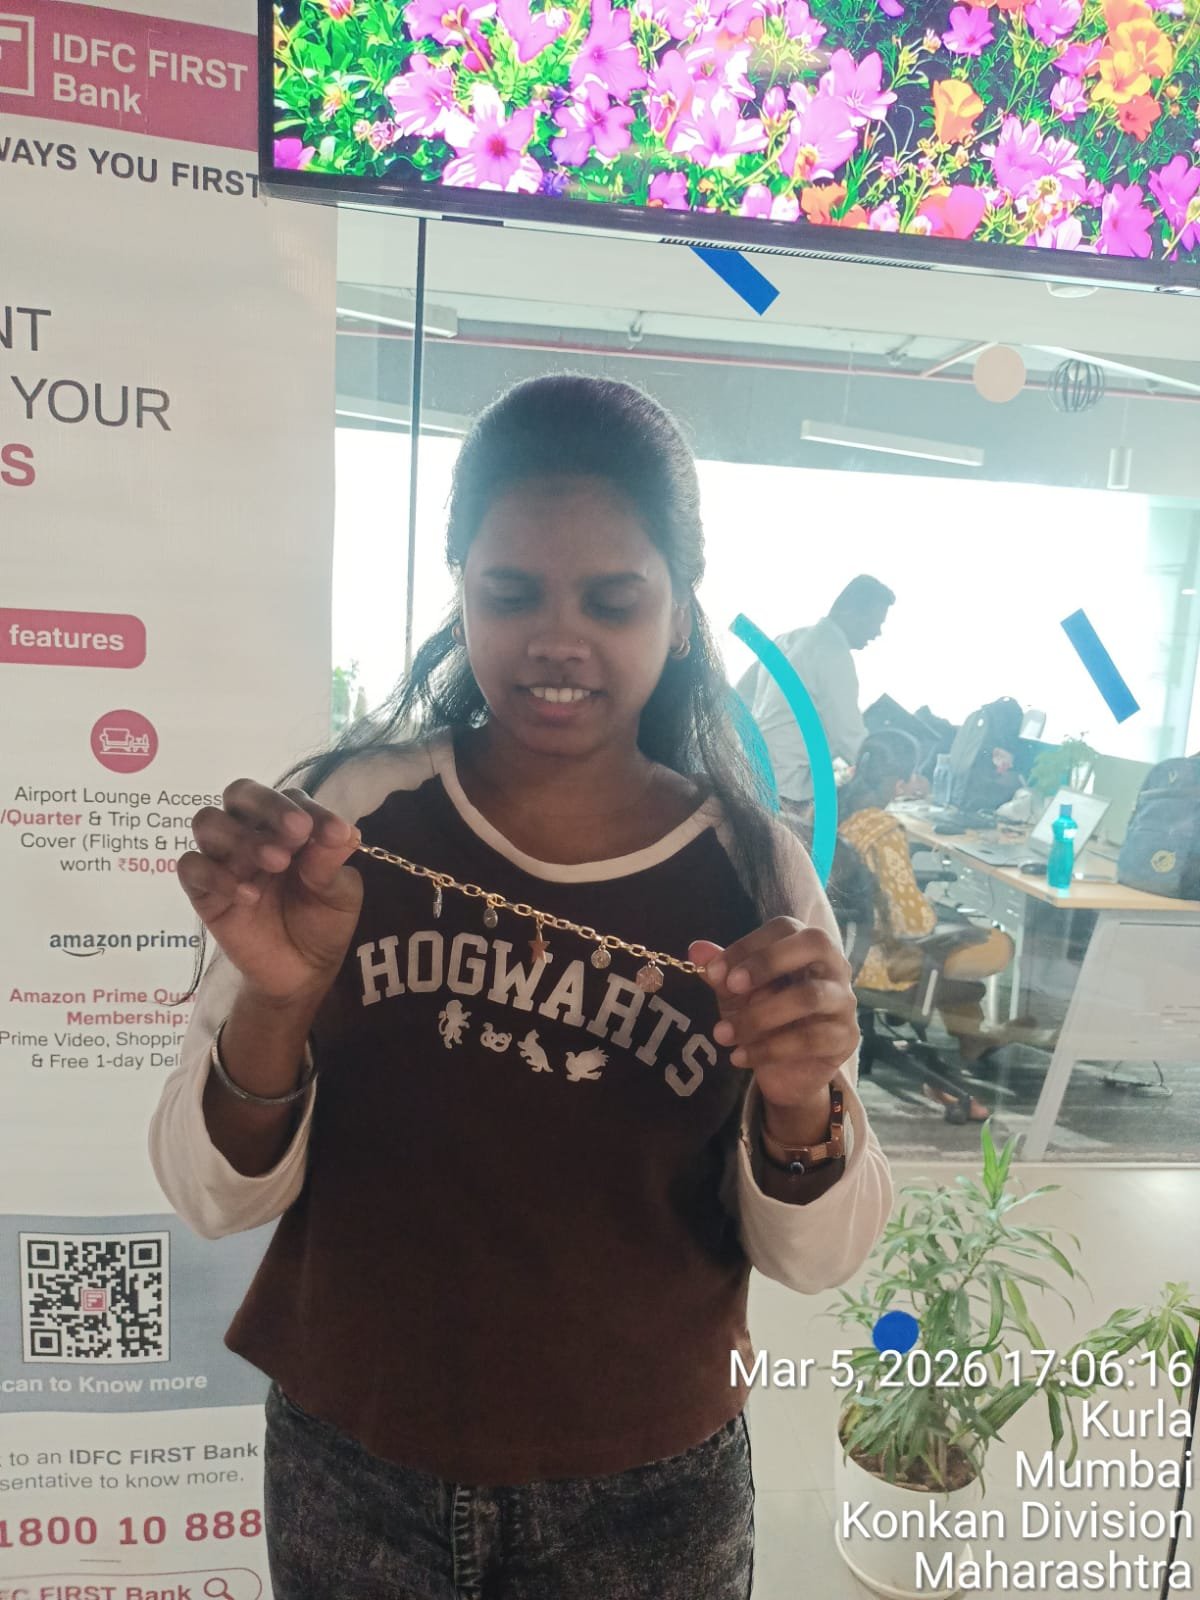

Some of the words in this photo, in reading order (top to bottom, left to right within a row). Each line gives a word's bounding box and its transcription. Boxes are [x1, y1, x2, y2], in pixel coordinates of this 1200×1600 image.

[53, 32, 136, 73] IDFC
[149, 50, 248, 92] FIRST
[53, 72, 142, 114] Bank
[88, 148, 158, 183] YOU
[172, 162, 259, 198] FIRST
[10, 375, 171, 431] YOUR
[9, 624, 125, 651] features
[14, 786, 77, 805] Airport
[83, 788, 151, 807] Lounge
[157, 790, 223, 806] Access
[89, 811, 101, 826] &
[109, 811, 141, 829] Trip
[21, 832, 76, 848] Cover
[82, 833, 149, 852] (Flights
[155, 835, 167, 850] &
[60, 857, 111, 872] worth
[50, 933, 132, 949] amazon
[137, 930, 201, 951] prime
[9, 988, 86, 1004] Amazon
[93, 988, 148, 1003] Prime
[67, 1010, 189, 1028] Membership:
[357, 931, 717, 1096] HOGWARTS
[0, 1031, 48, 1046] Prime
[54, 1032, 110, 1048] Video,
[32, 1054, 42, 1068] &
[50, 1054, 88, 1068] Free
[97, 1053, 144, 1070] 1-day
[49, 1376, 72, 1392] to
[79, 1375, 142, 1393] Know
[150, 1374, 208, 1391] more
[9, 1452, 29, 1466] to
[37, 1452, 61, 1465] an
[69, 1449, 121, 1465] IDFC
[130, 1446, 196, 1465] FIRST
[204, 1443, 258, 1460] Bank
[100, 1474, 119, 1489] to
[126, 1471, 179, 1489] know
[187, 1468, 244, 1485] more.
[0, 1516, 97, 1547] 1800
[119, 1516, 166, 1545] 10
[185, 1509, 262, 1541] 888
[41, 1585, 116, 1600] FIRST
[126, 1584, 191, 1600] Bank
